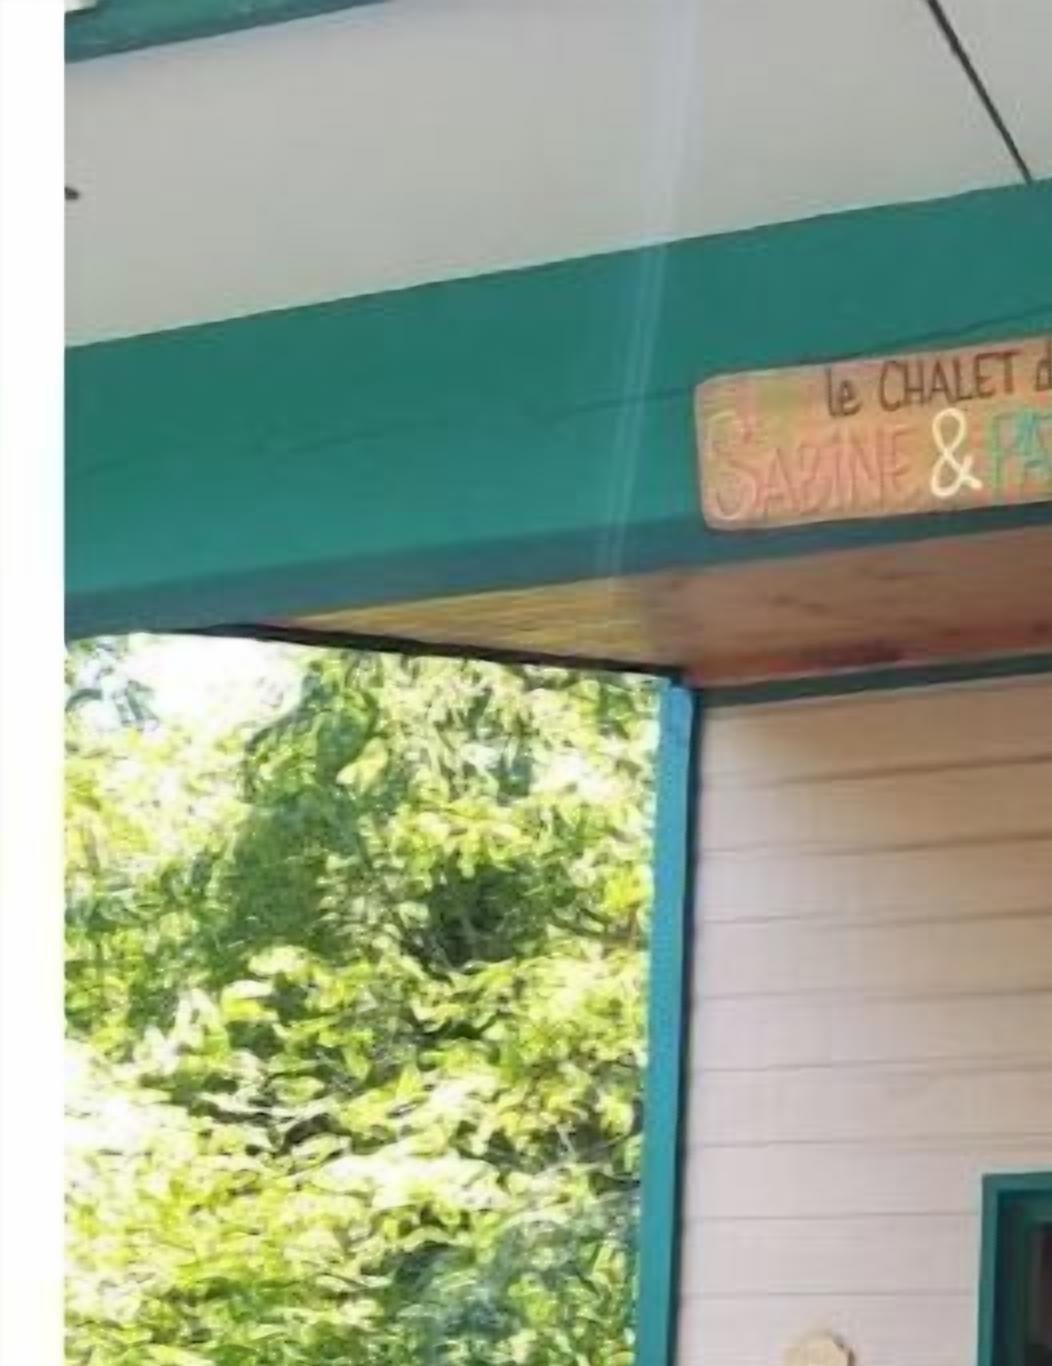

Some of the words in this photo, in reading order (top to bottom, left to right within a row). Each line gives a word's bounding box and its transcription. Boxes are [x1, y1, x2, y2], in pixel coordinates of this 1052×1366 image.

[823, 365, 864, 420] le
[876, 350, 1022, 411] CHALET
[929, 406, 983, 498] &
